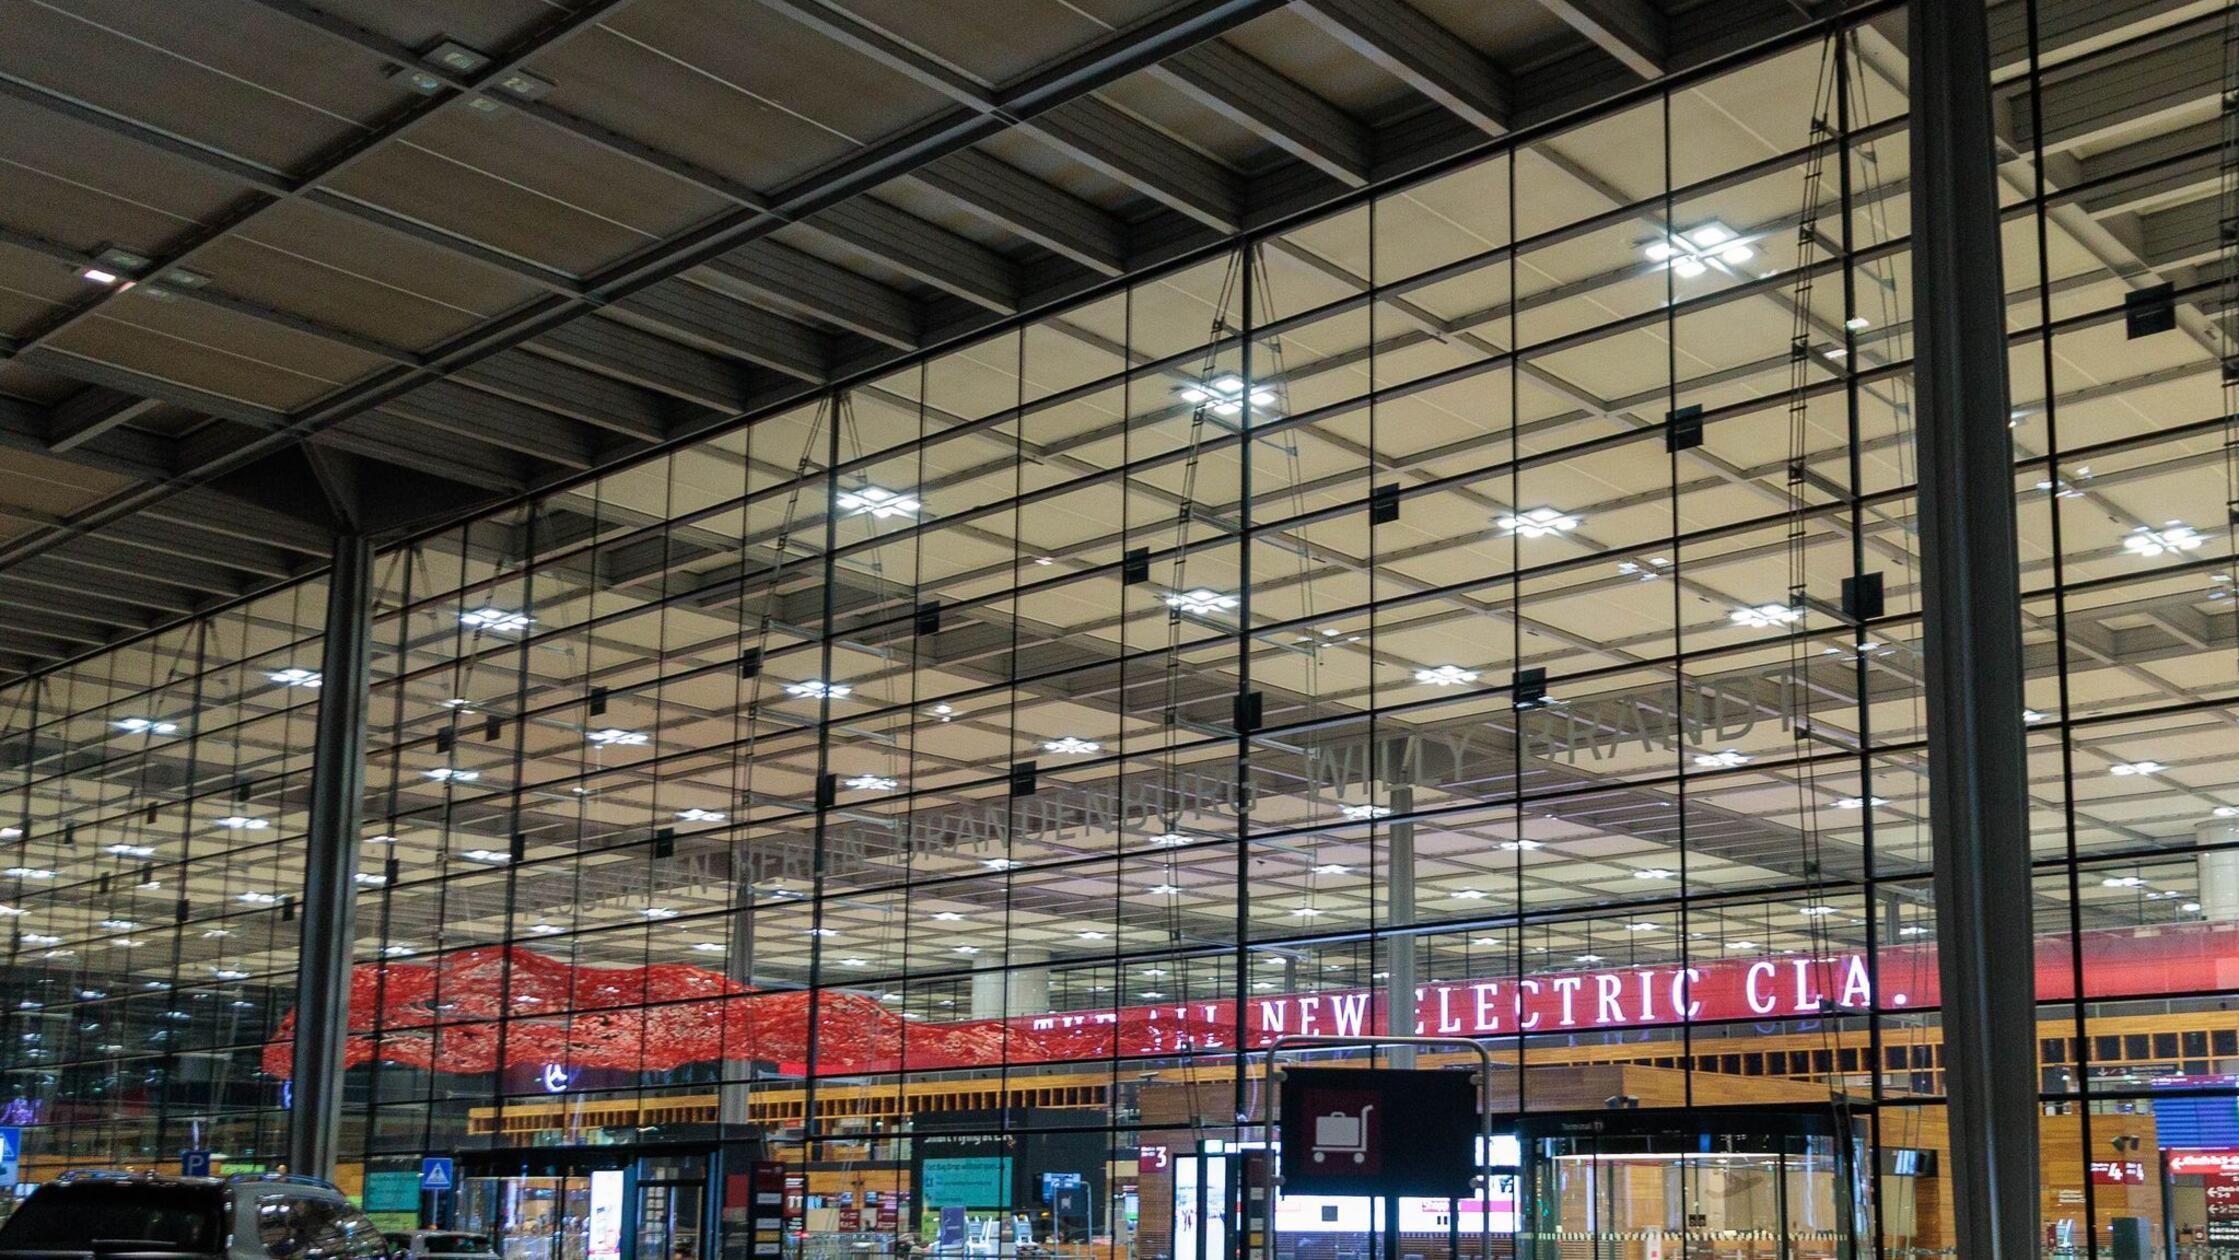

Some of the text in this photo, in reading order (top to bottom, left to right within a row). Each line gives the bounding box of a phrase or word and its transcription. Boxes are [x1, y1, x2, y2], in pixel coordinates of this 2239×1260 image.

[1304, 731, 1472, 800] WILLY
[1520, 670, 1797, 765] BRANDT
[1260, 993, 1370, 1045] NEW
[1413, 967, 1702, 1034] LECTRIC
[188, 1154, 204, 1177] P
[1155, 1146, 1167, 1168] 3
[2108, 1162, 2123, 1180] 4
